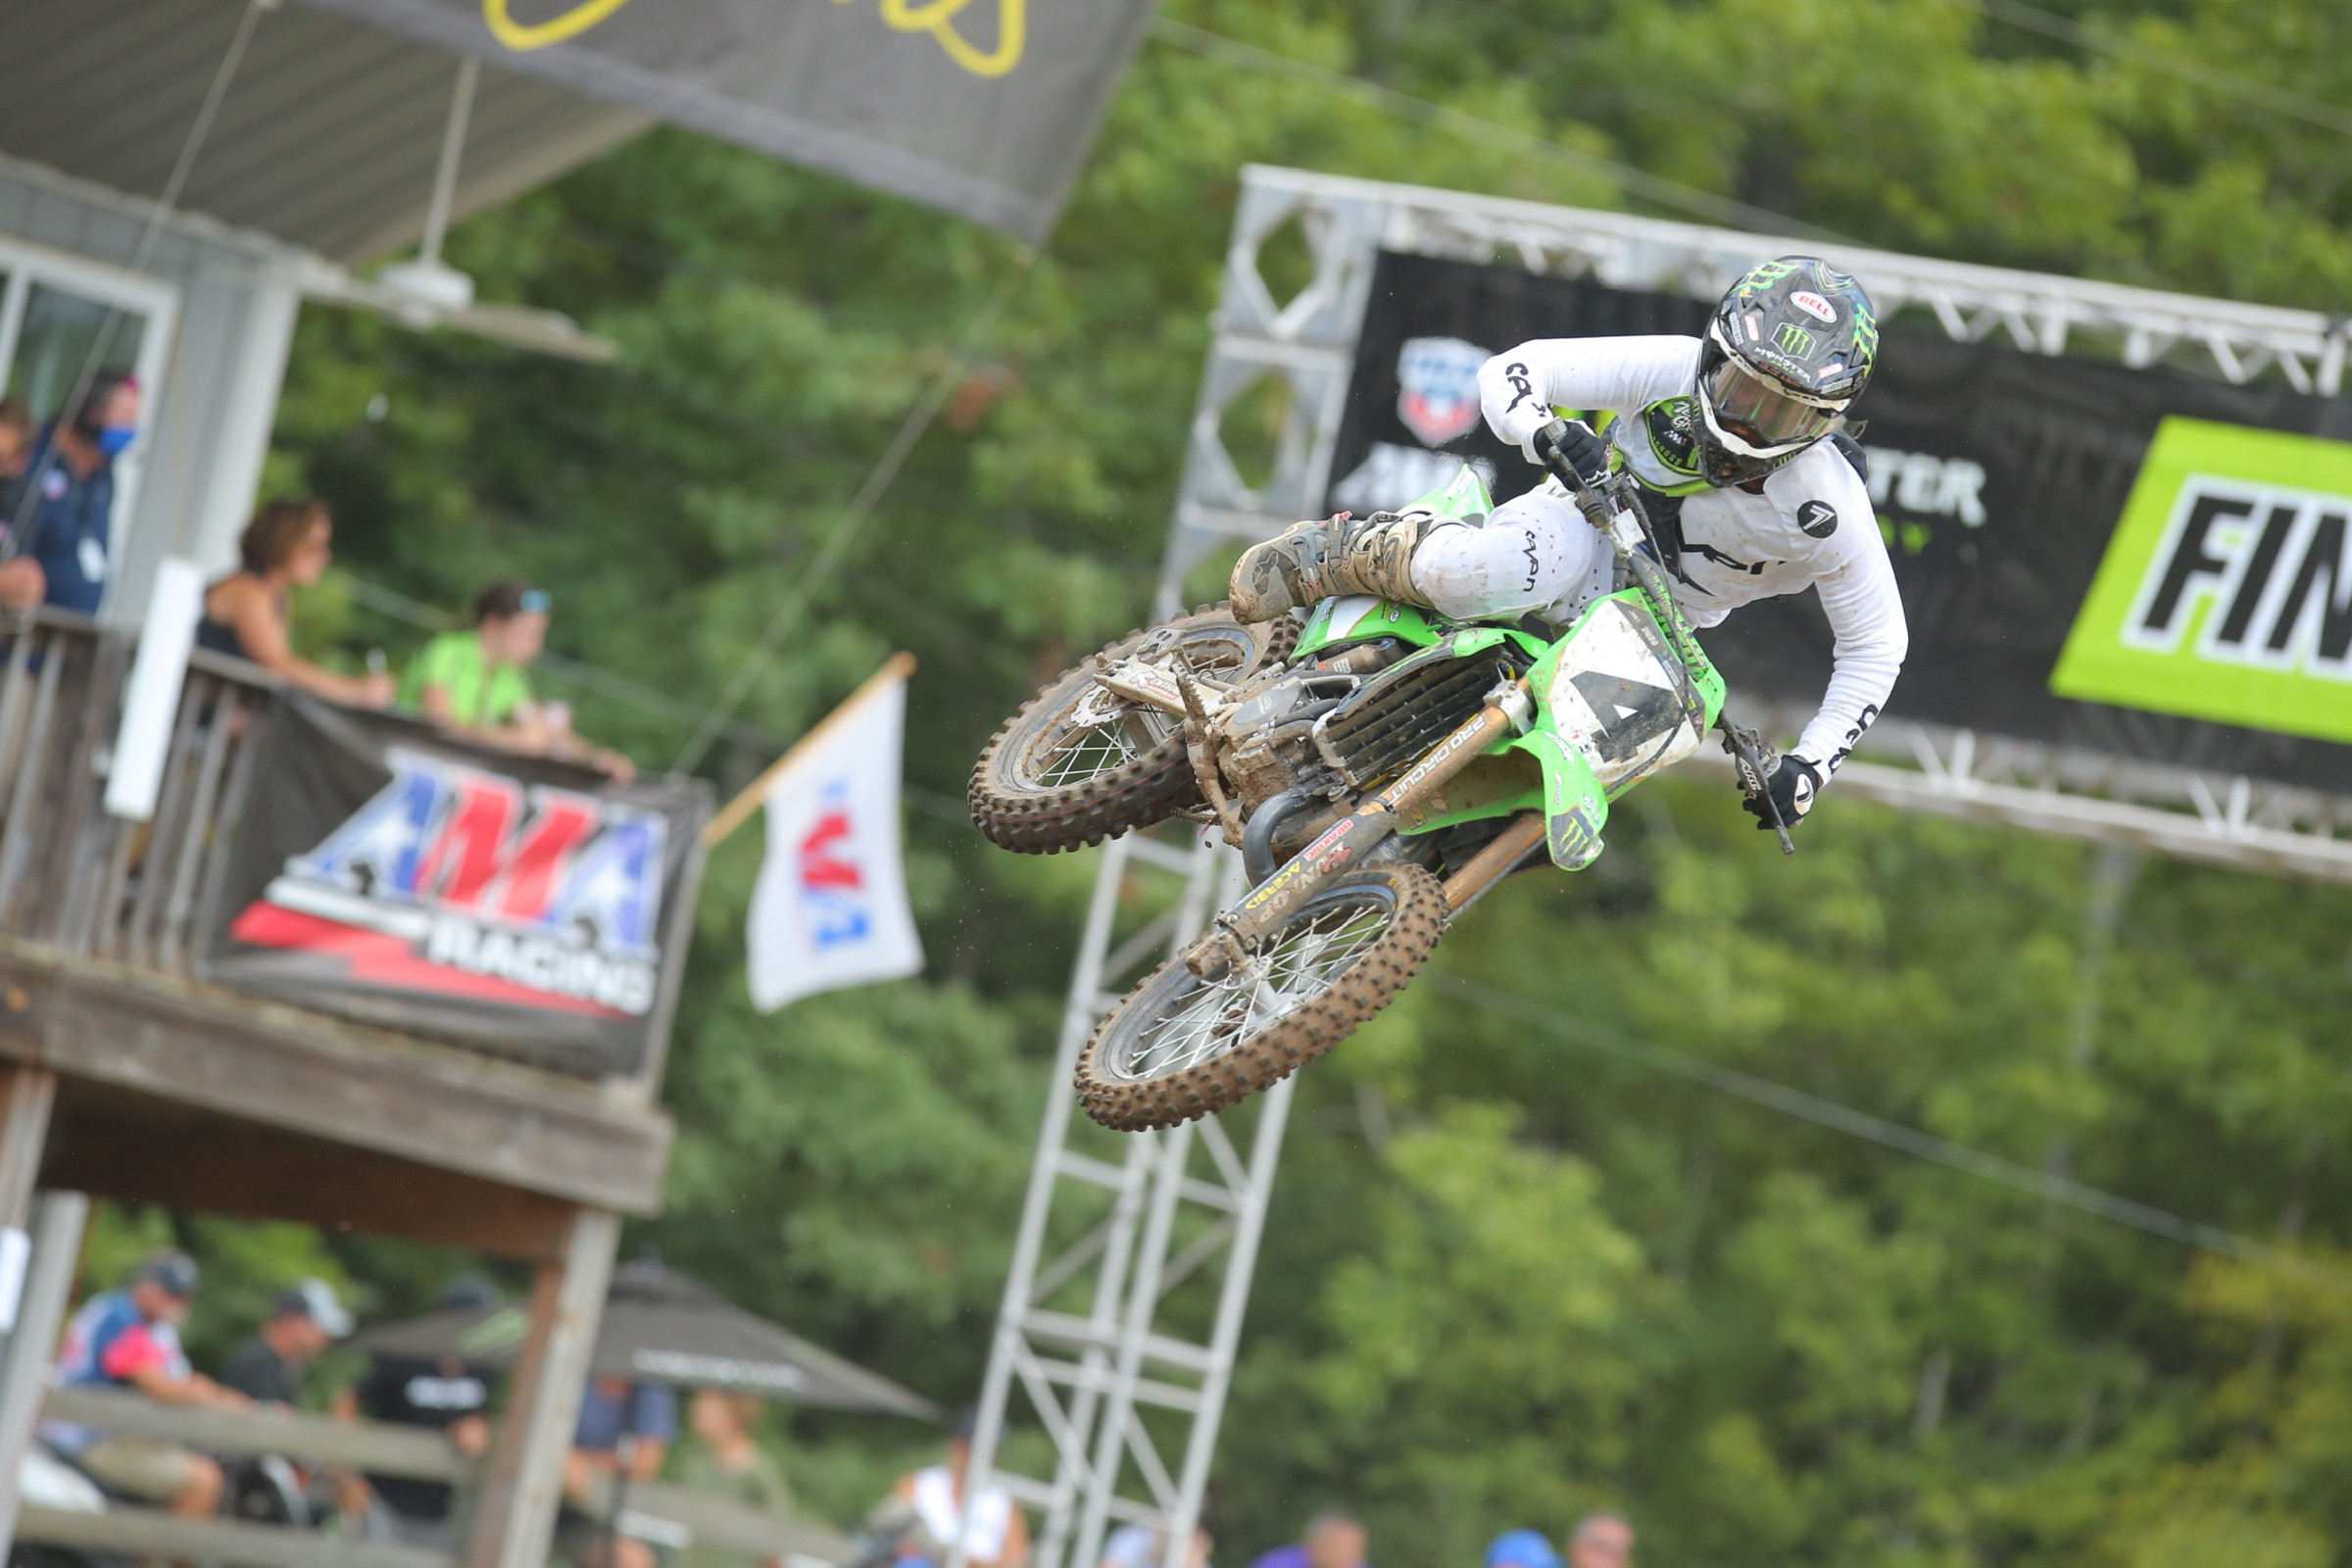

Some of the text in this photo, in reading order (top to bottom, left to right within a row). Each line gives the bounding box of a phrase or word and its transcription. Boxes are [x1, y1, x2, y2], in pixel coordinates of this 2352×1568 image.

[1798, 294, 1830, 318] BELL
[1754, 346, 1811, 383] MONSTER
[1451, 714, 1487, 751] PRO
[1569, 670, 1687, 763] 4
[1388, 748, 1451, 807] CIRCUIT
[284, 747, 668, 960] AMA
[1304, 821, 1354, 861] BRAKING
[426, 917, 657, 1016] RACING
